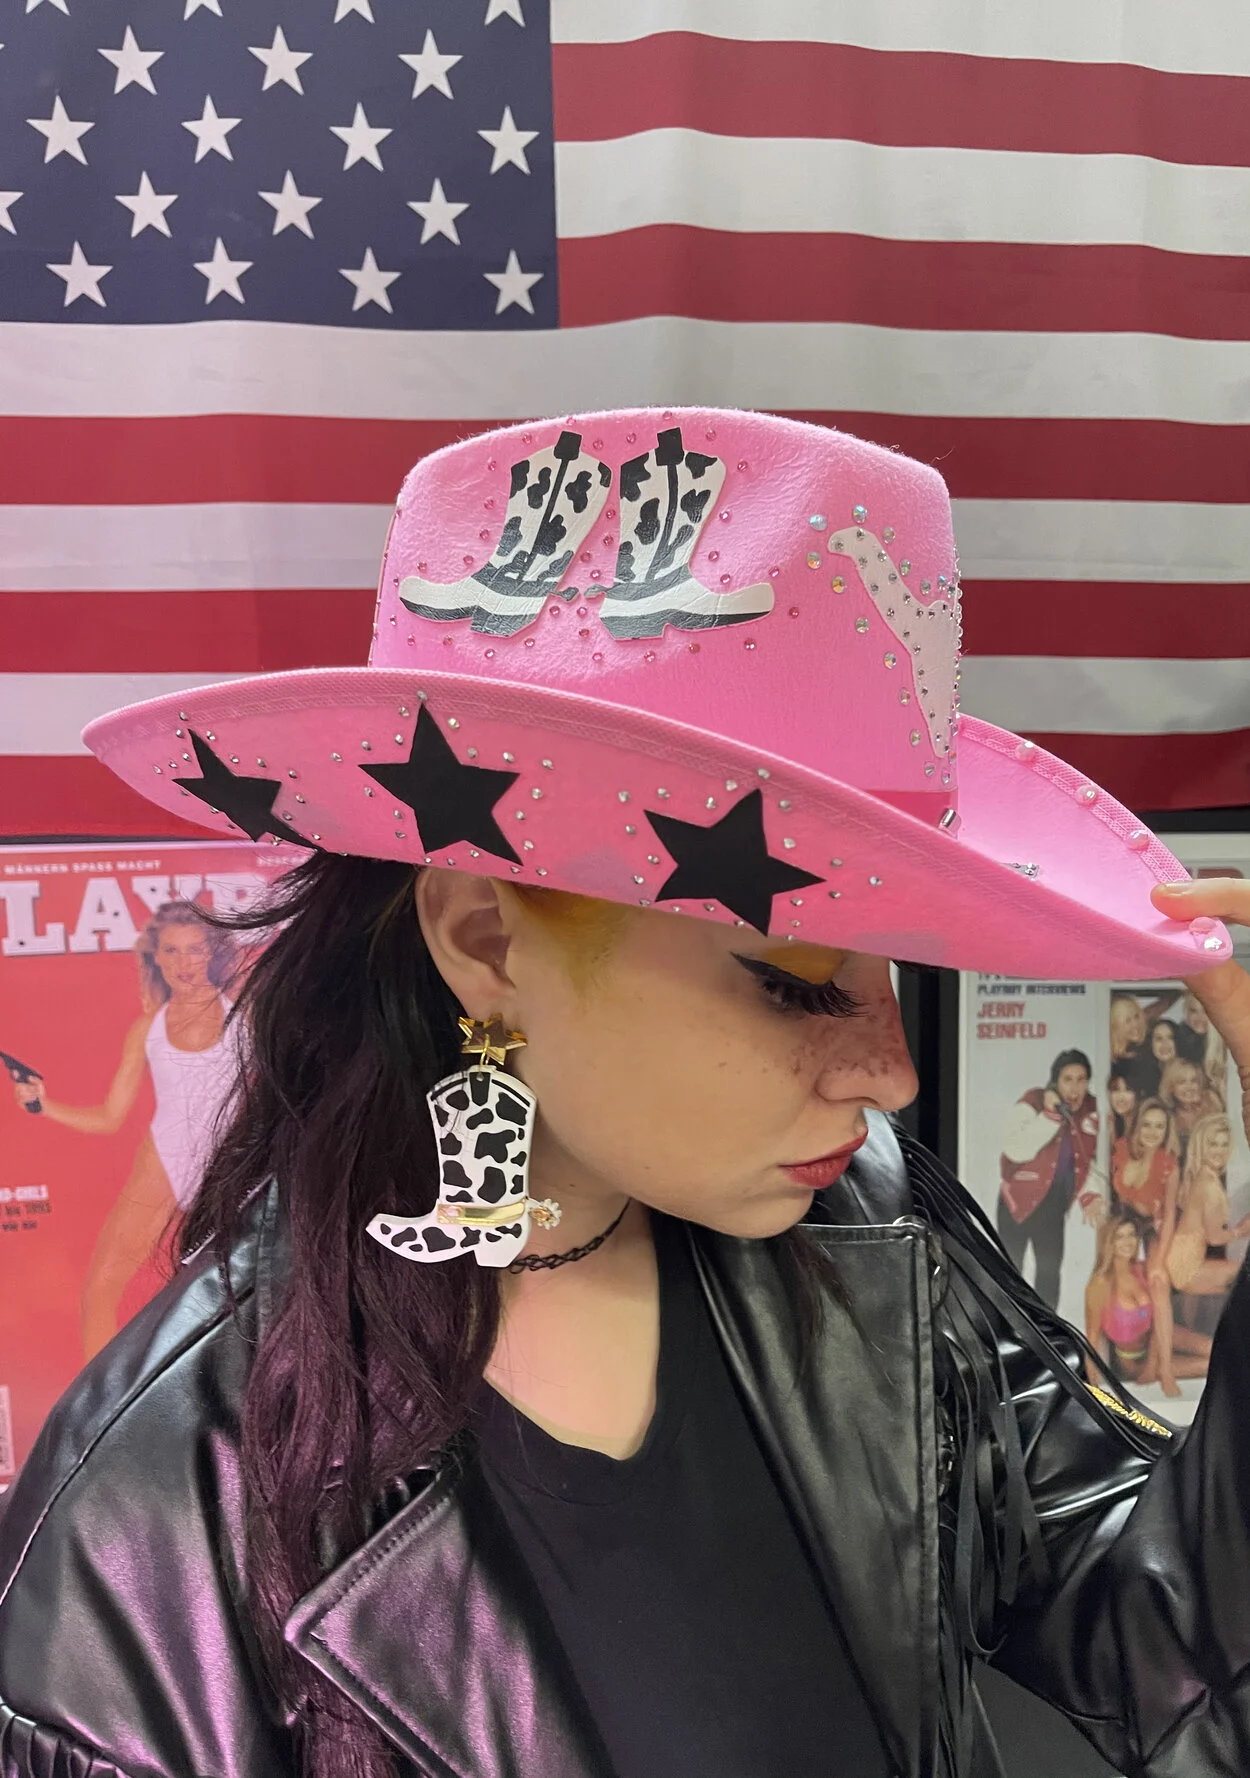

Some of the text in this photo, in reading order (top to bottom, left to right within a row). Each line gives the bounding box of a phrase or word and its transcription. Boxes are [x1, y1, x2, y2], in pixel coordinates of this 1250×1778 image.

[116, 860, 161, 871] MACHT
[977, 1001, 1025, 1018] JERRY
[977, 1022, 1047, 1040] SEINFELD
